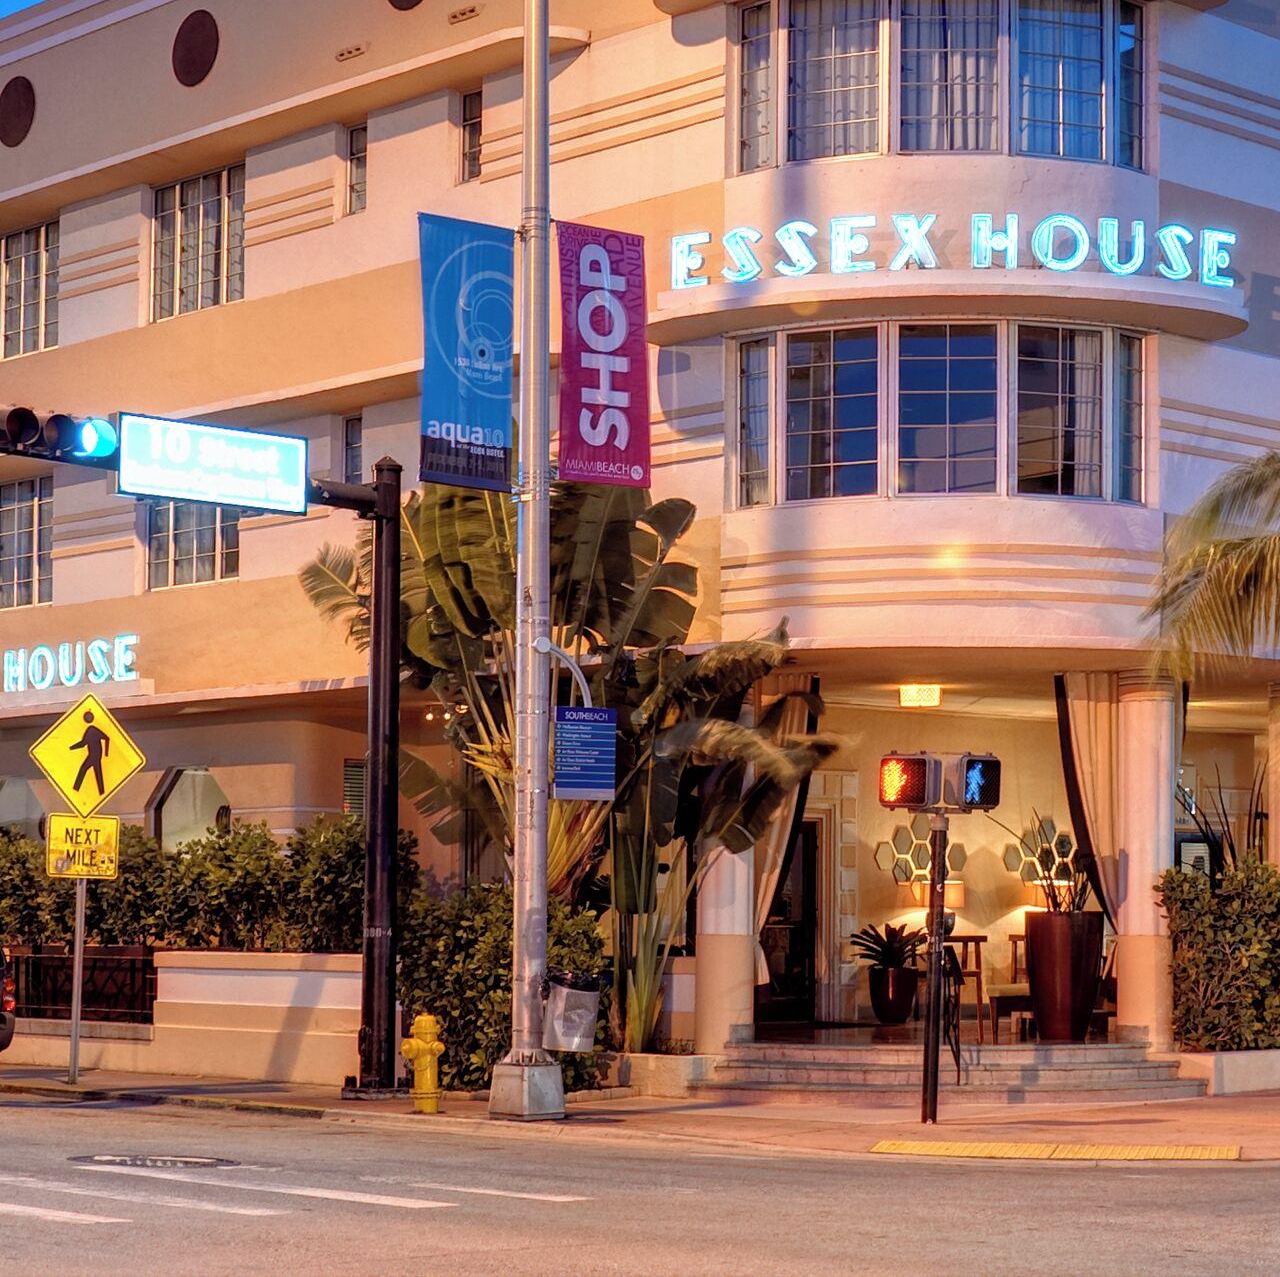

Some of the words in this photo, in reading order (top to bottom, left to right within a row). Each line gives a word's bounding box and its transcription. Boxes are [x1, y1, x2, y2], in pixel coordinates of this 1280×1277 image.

[671, 214, 938, 290] ESSEX
[970, 212, 1239, 289] HOUSE
[578, 243, 631, 450] SHOP
[3, 634, 140, 692] HOUSE
[65, 827, 101, 845] NEXT
[66, 849, 97, 867] MILE
